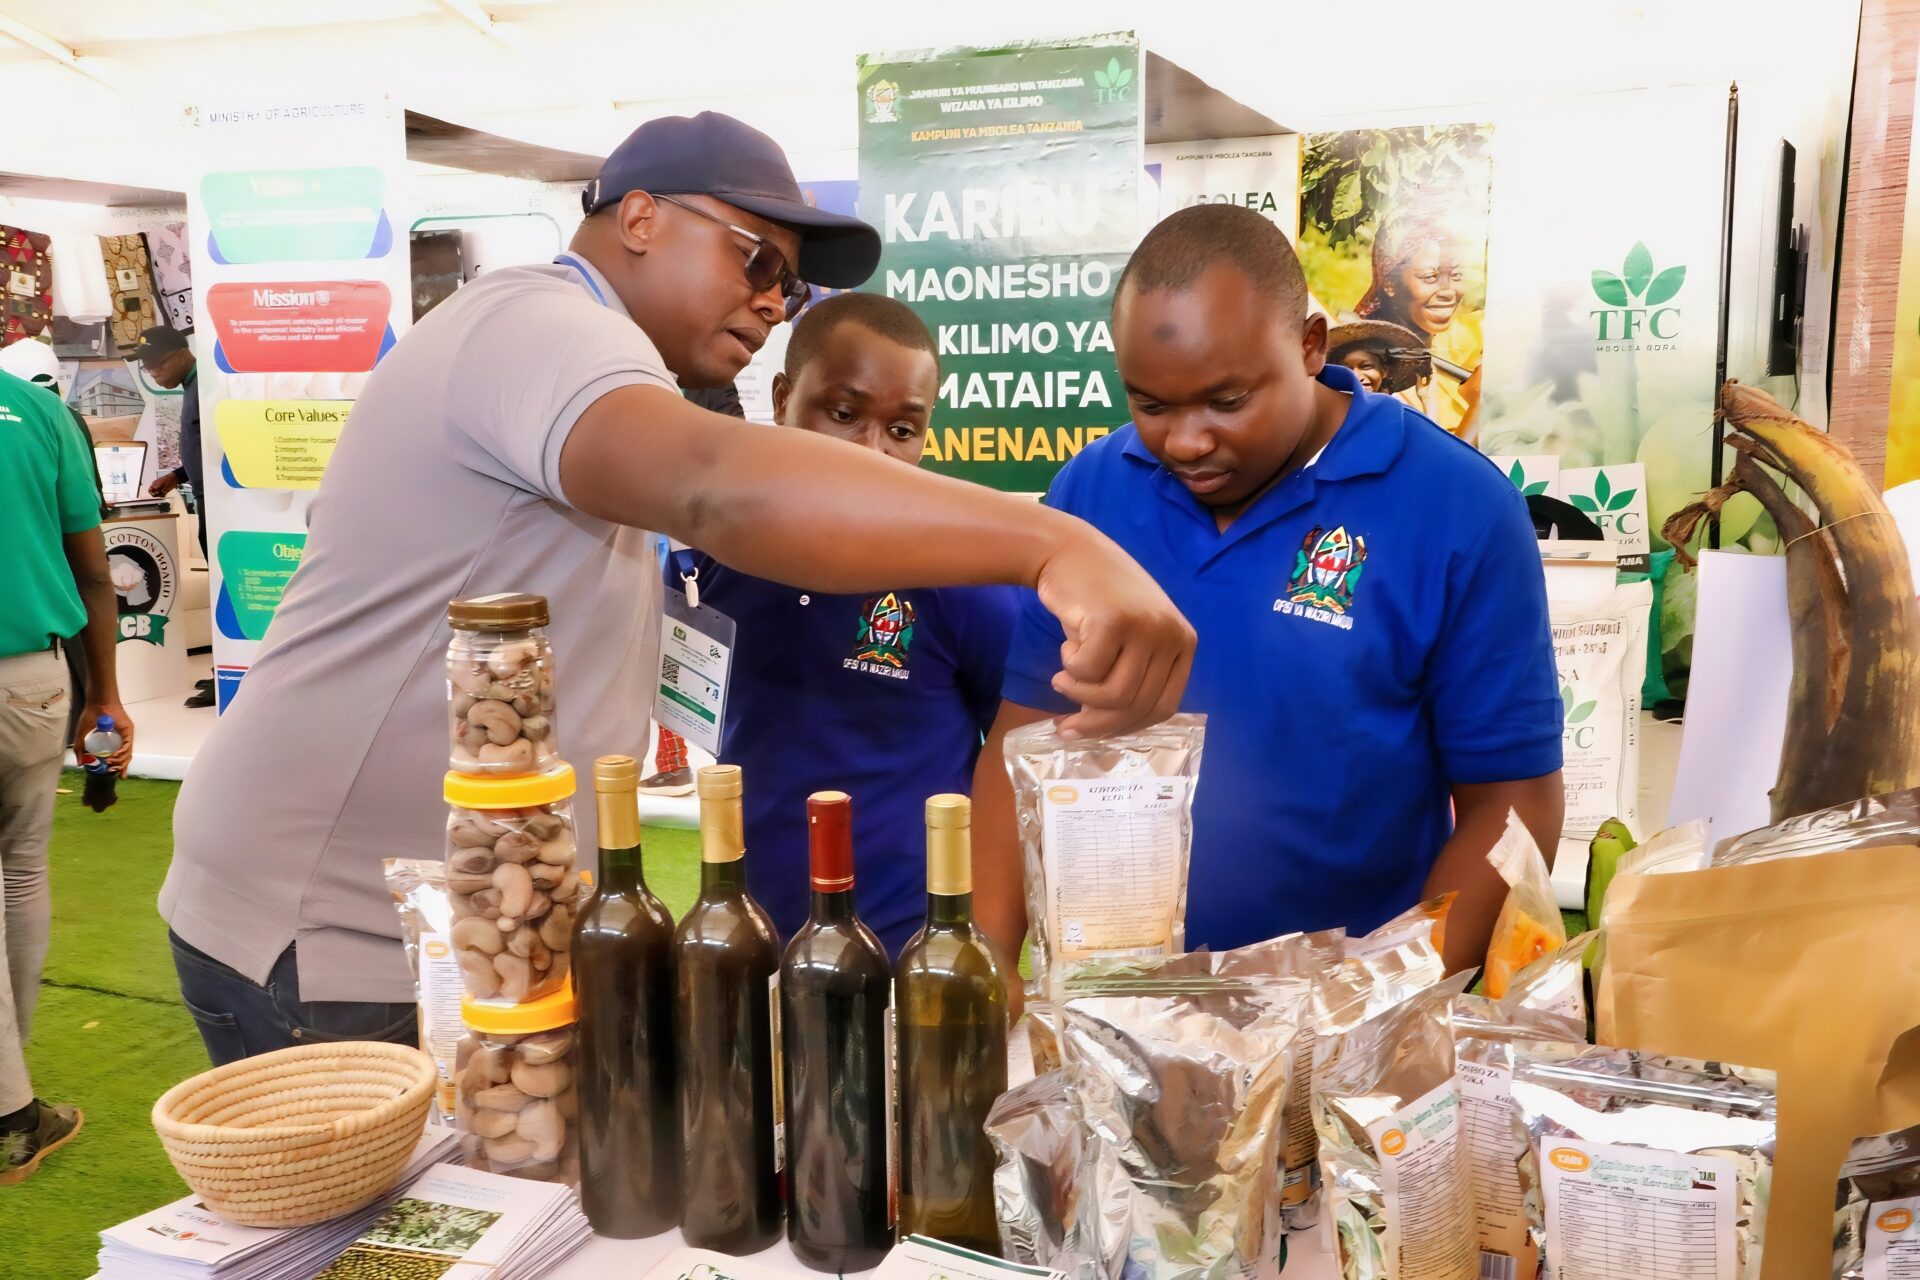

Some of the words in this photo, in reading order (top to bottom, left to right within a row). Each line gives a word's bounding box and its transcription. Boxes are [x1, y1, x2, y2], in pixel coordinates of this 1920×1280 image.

[940, 100, 986, 113] WIZARA
[986, 98, 1002, 110] YA
[1095, 87, 1131, 104] TFC
[962, 127, 977, 139] YA
[1027, 120, 1084, 134] TANZANIA
[886, 260, 1111, 302] MAONESHO
[253, 288, 315, 307] Mission
[1590, 308, 1681, 341] TFC
[938, 321, 1059, 355] KILIMO
[1066, 320, 1116, 353] YA
[933, 370, 1113, 409] MATAIFA
[265, 407, 295, 423] Core
[297, 408, 339, 423] Values
[1595, 512, 1641, 535] FC
[109, 533, 157, 553] COTTON
[155, 553, 171, 598] BOARD
[116, 615, 152, 638] CB
